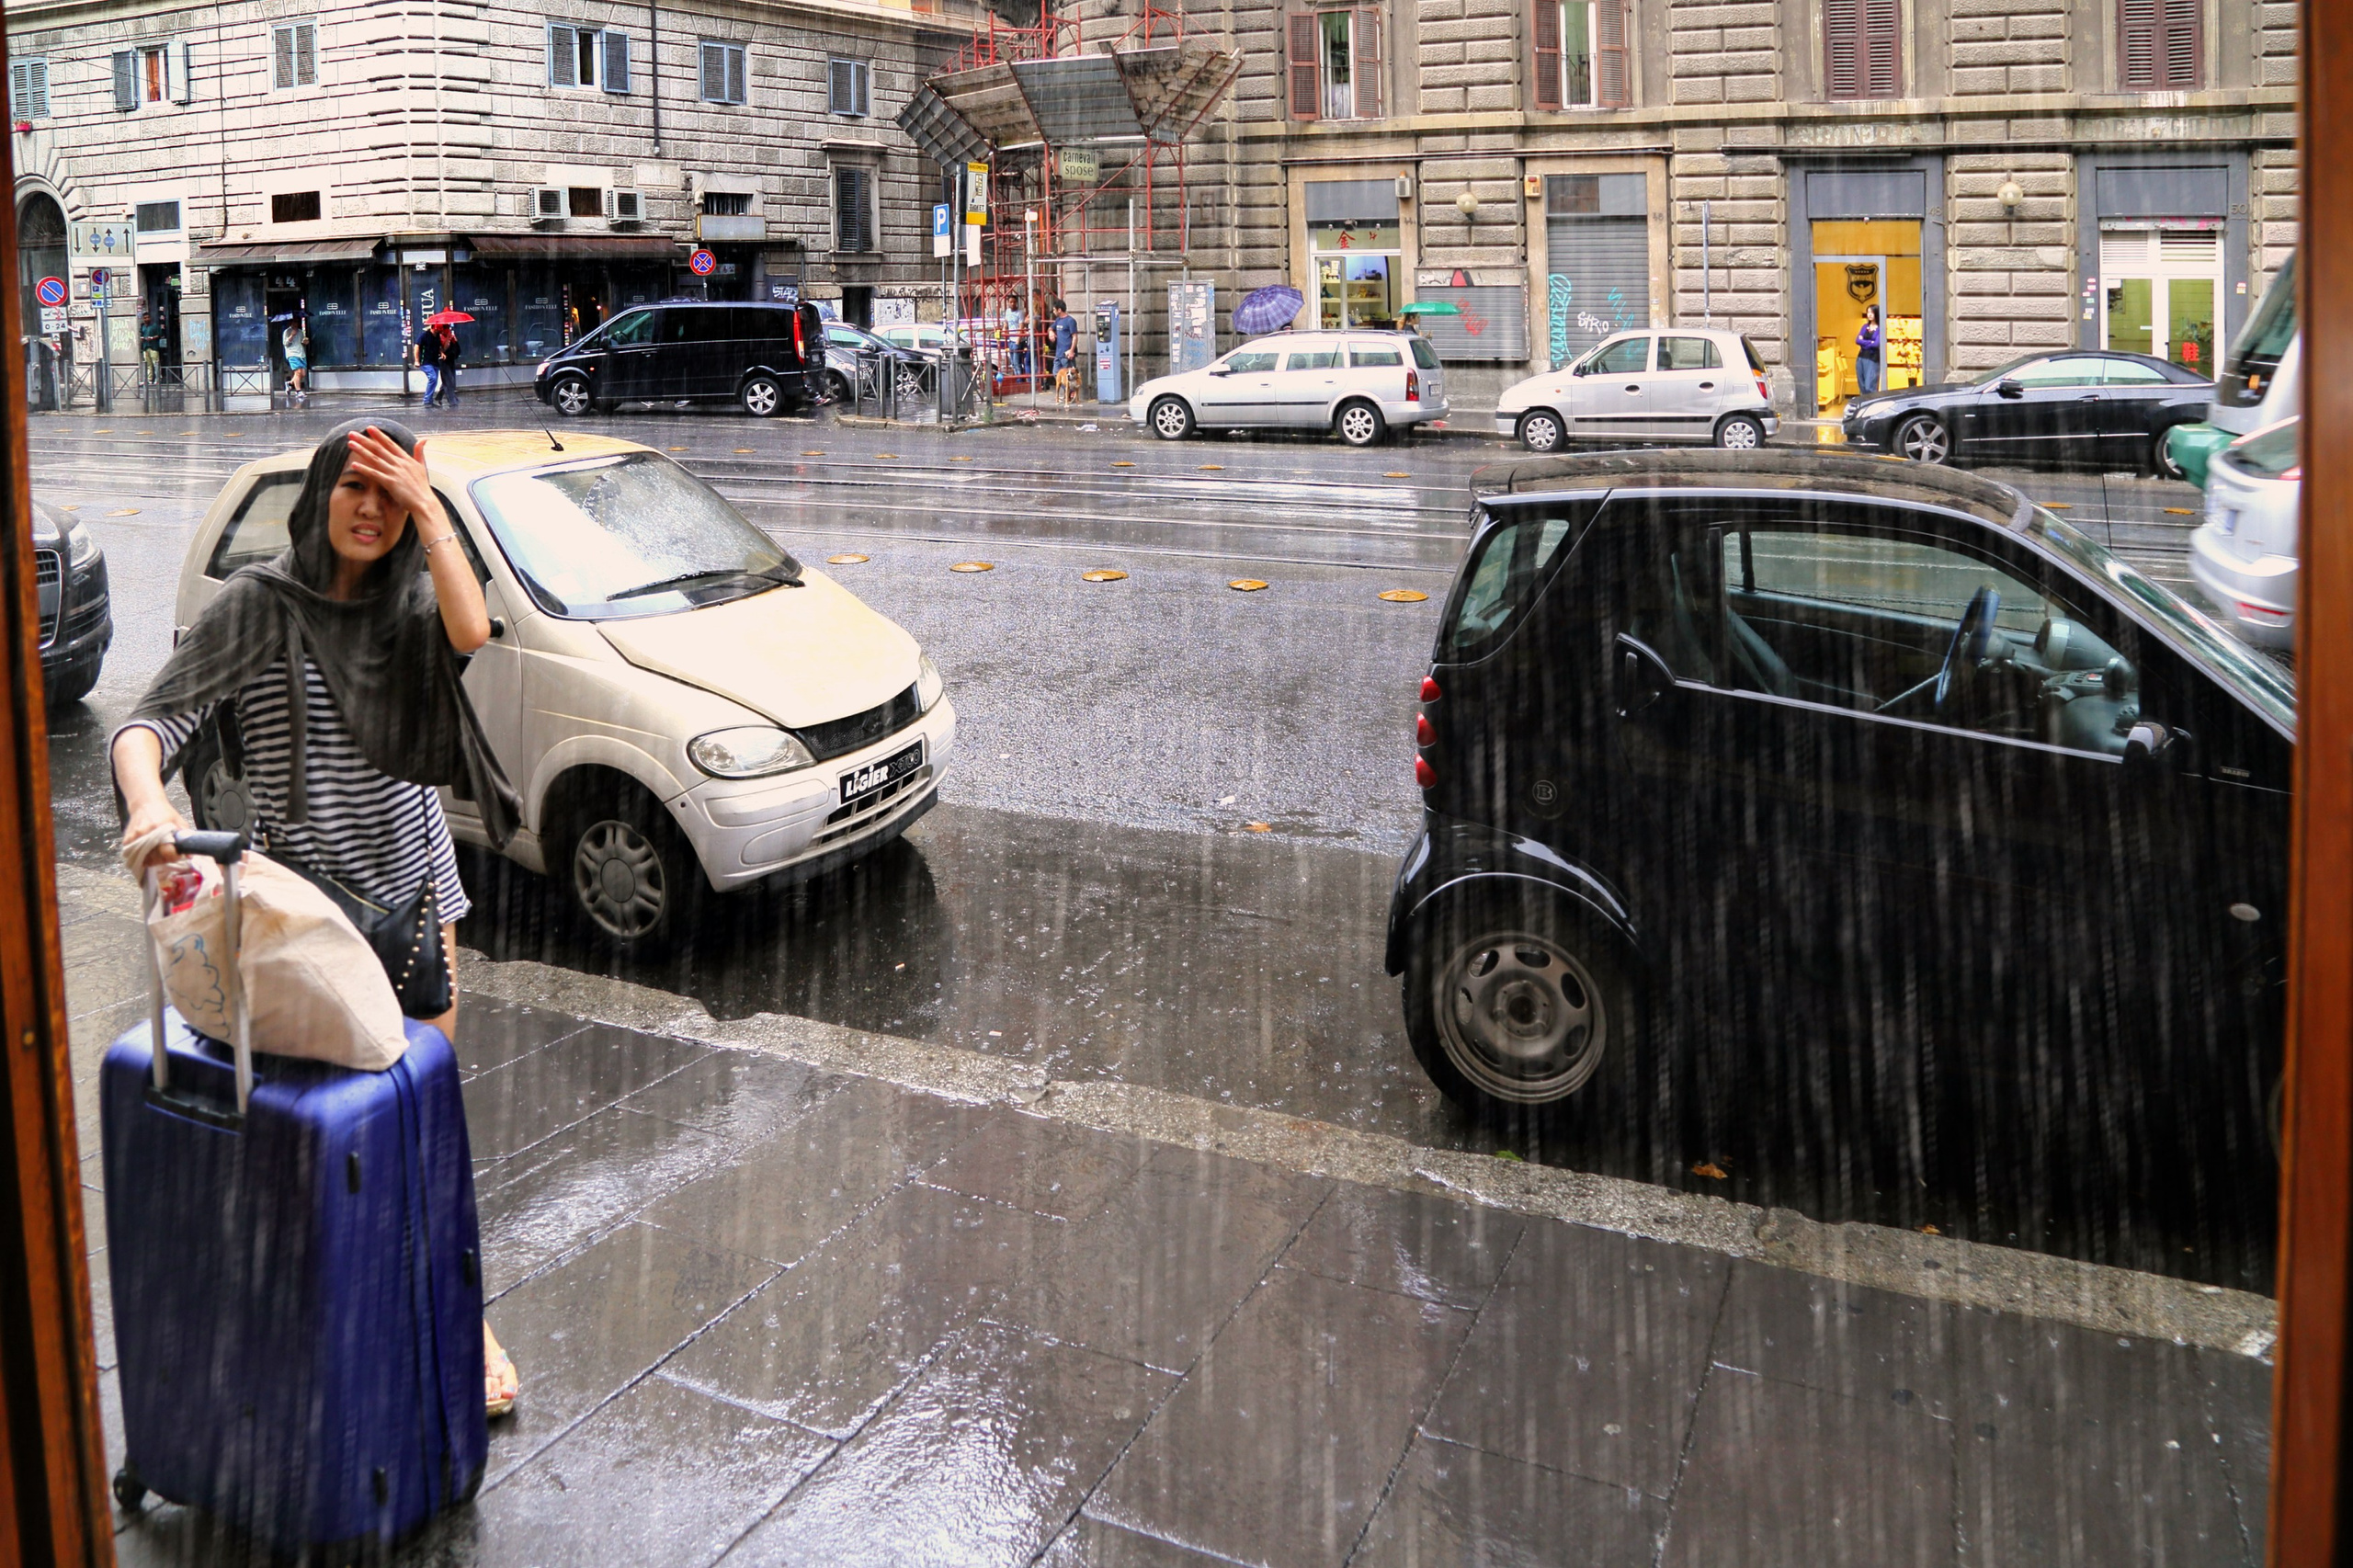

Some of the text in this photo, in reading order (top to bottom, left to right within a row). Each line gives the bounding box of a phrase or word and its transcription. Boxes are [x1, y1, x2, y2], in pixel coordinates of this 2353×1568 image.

[1063, 151, 1096, 165] carnevali
[1064, 165, 1094, 178] spose
[2231, 204, 2249, 215] 50
[936, 208, 947, 233] P
